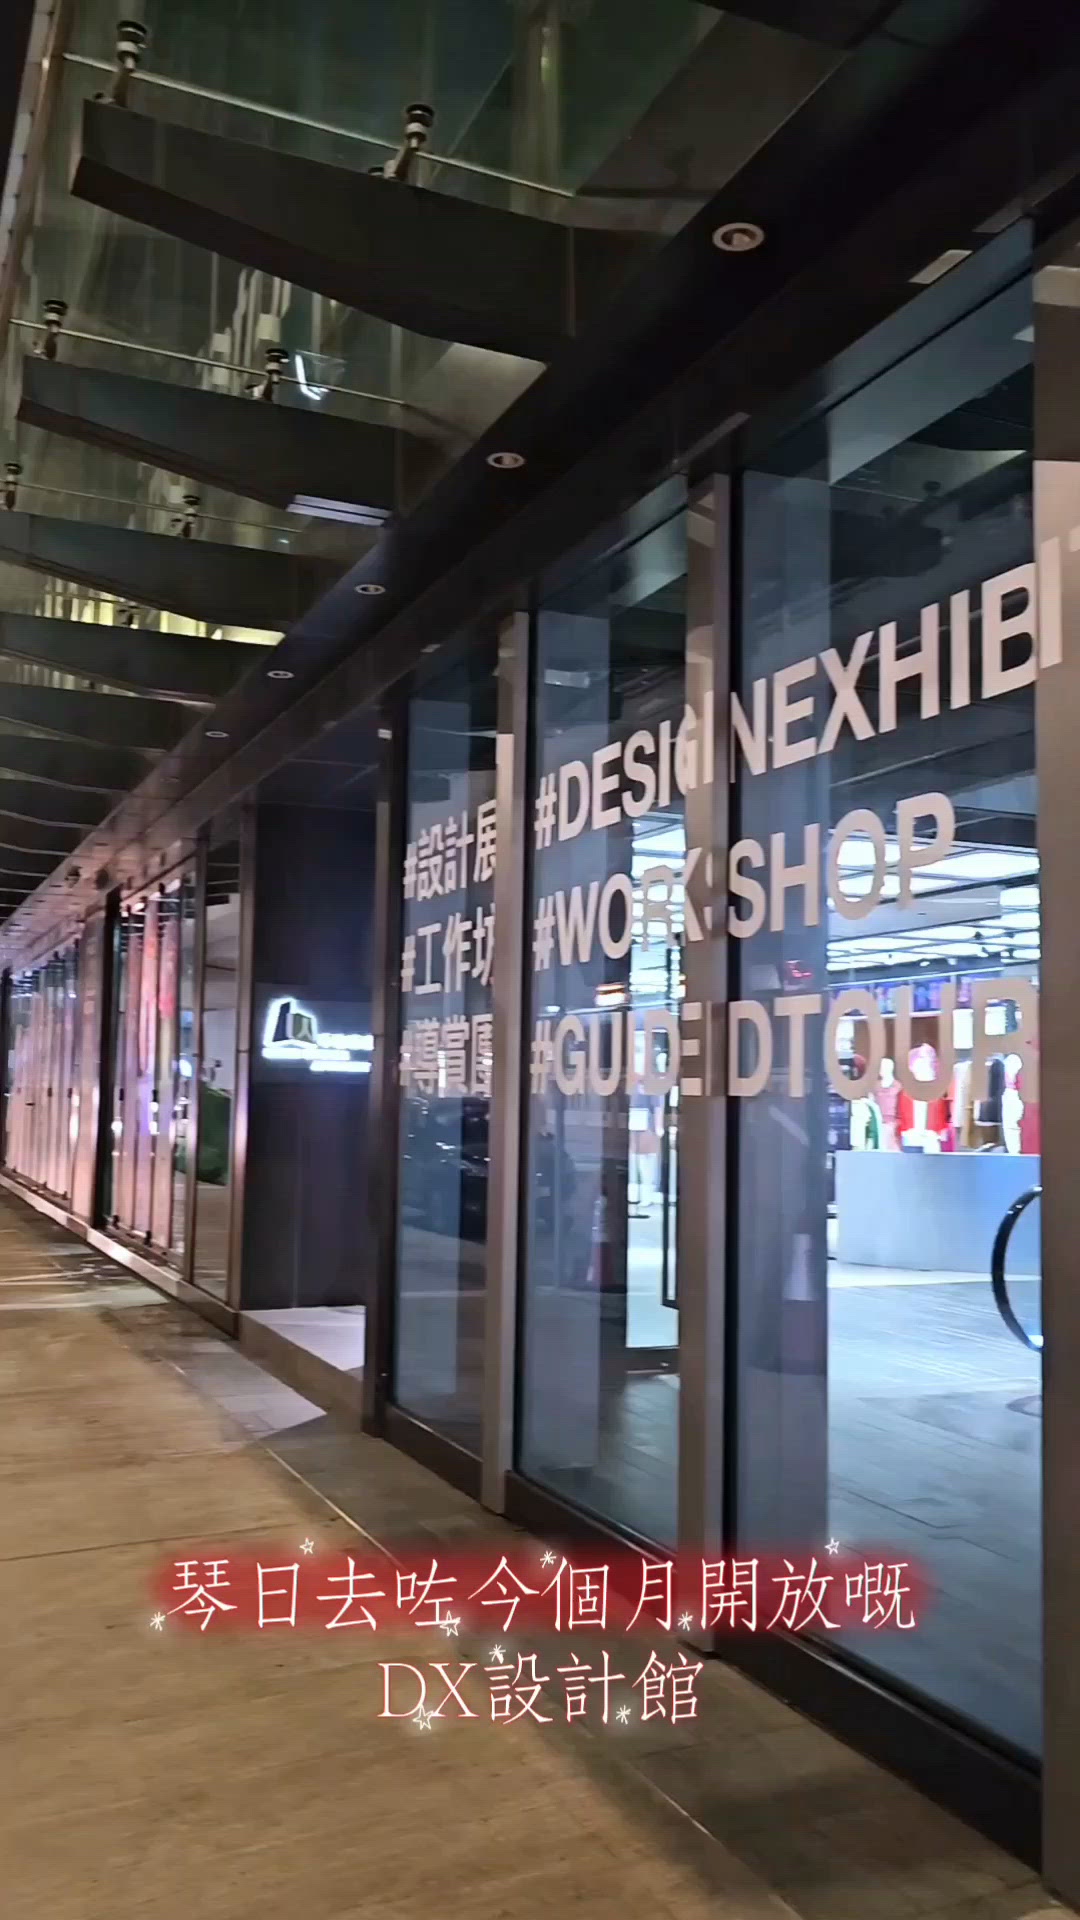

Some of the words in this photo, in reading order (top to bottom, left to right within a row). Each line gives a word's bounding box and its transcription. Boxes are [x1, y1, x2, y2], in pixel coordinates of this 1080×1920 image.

[403, 799, 497, 901] #設計展
[532, 792, 955, 971] #WORKSHOP
[529, 979, 1041, 1104] #GUIDEDTOUR
